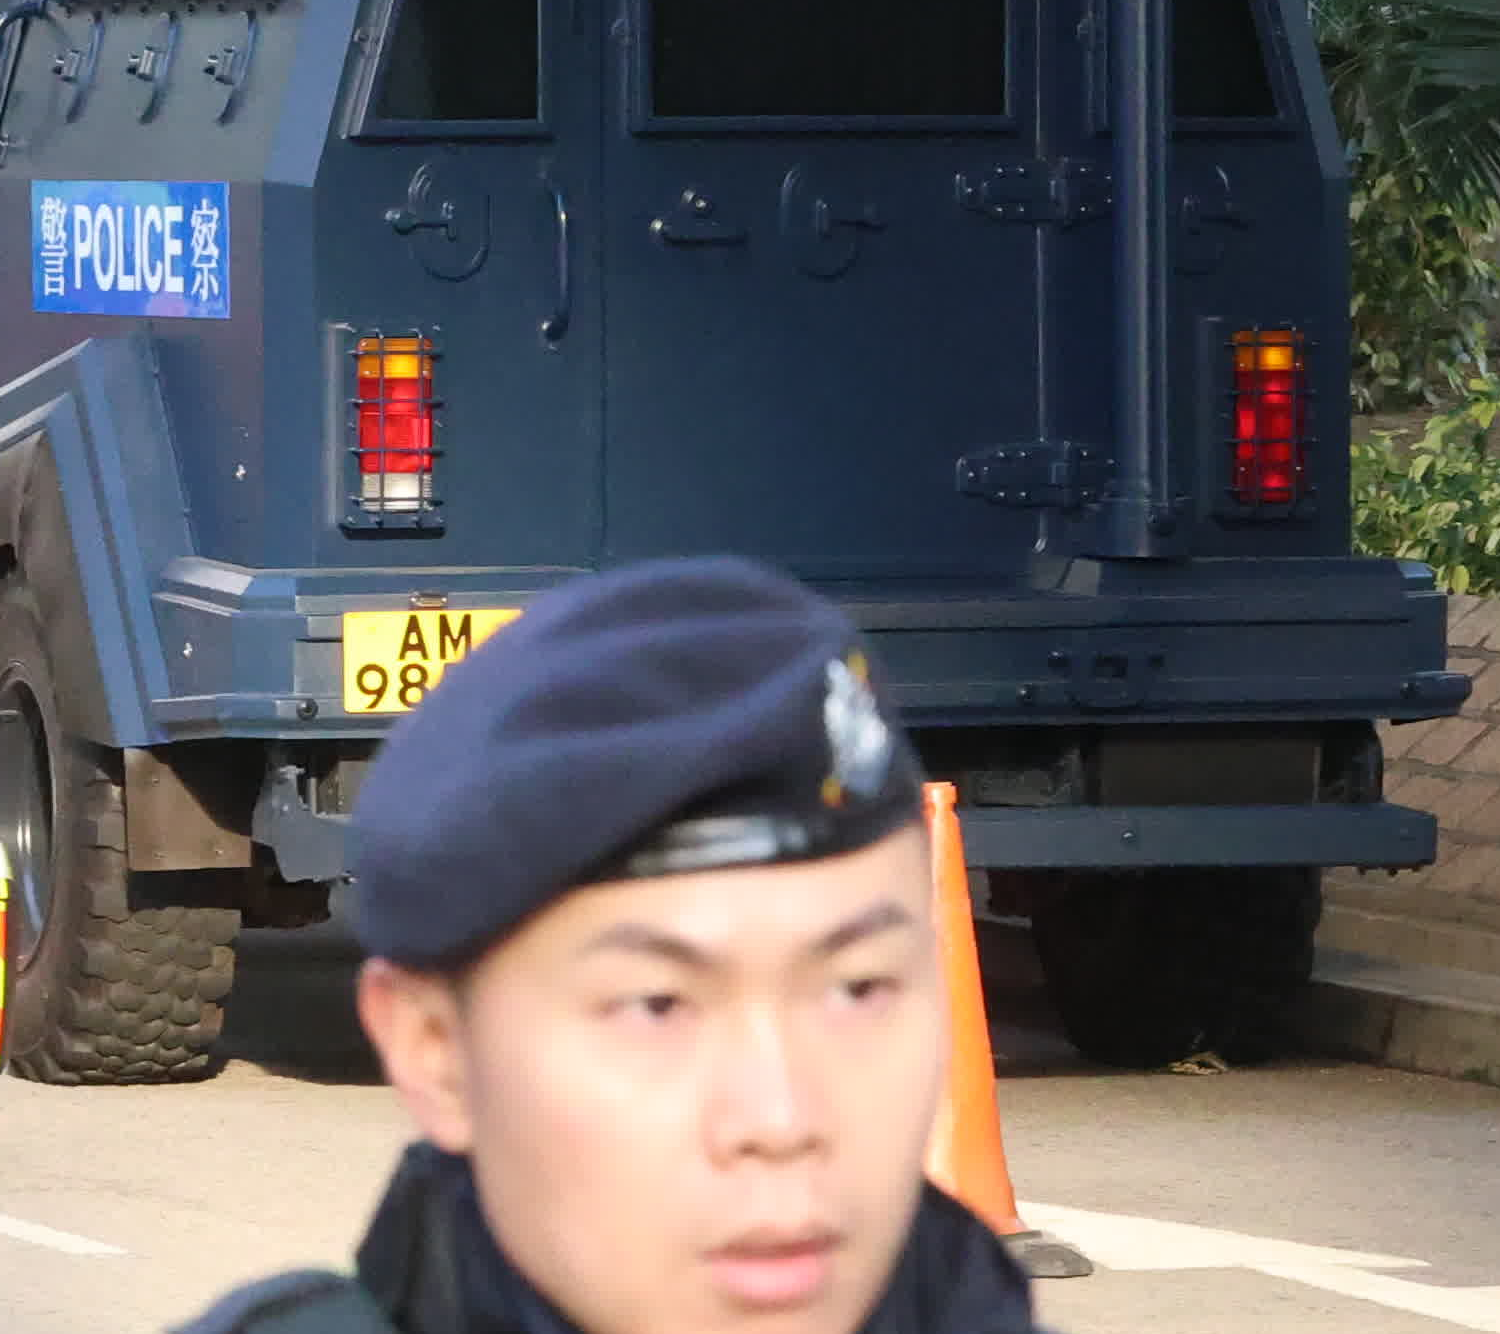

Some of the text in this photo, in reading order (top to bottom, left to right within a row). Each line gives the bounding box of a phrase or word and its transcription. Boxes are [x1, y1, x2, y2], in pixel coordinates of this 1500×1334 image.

[40, 197, 219, 302] 警 POLICE 察
[398, 614, 472, 660] AM
[357, 663, 428, 709] 98
